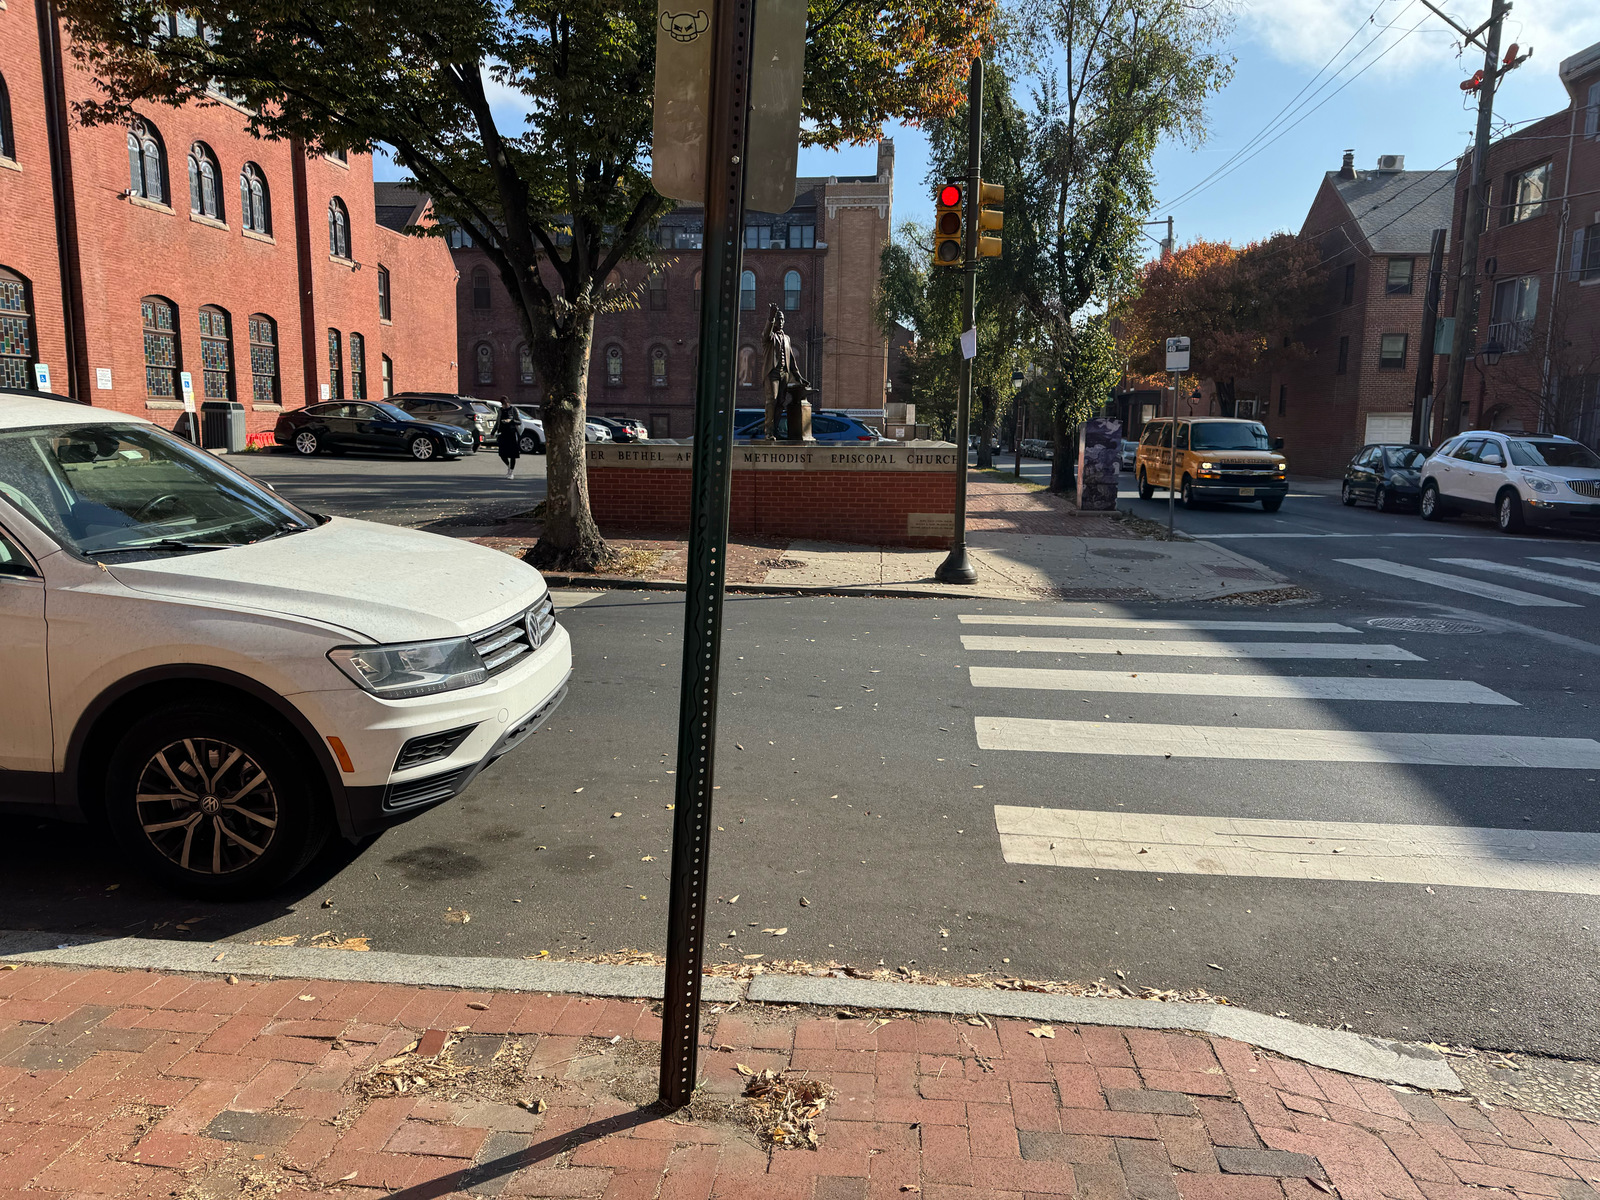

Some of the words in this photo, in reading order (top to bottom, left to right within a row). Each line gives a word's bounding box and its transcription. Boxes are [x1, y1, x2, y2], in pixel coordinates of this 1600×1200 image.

[618, 451, 665, 461] BETHEL
[744, 453, 814, 463] METHODIST
[831, 454, 896, 464] EPISCOPAL
